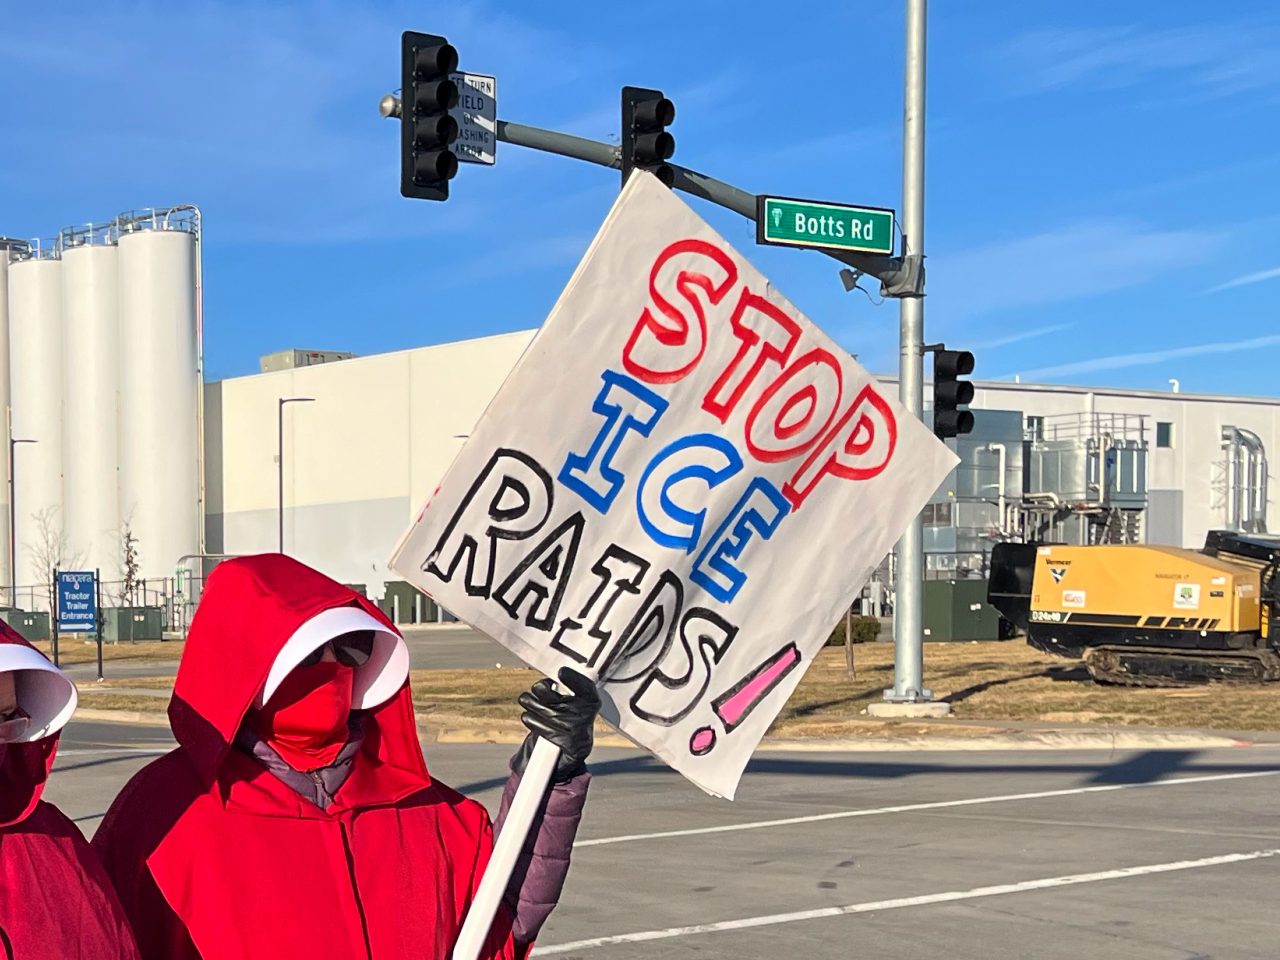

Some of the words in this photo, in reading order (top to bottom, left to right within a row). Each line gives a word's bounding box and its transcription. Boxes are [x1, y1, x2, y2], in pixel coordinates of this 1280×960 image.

[468, 79, 492, 94] TURN
[457, 95, 484, 111] IELD
[795, 213, 844, 238] Botts
[851, 218, 874, 241] Rd
[622, 239, 898, 513] STOP
[557, 369, 792, 603] ICE
[64, 591, 90, 600] Tractor
[422, 447, 802, 756] RAIDS!
[66, 601, 89, 610] Trailer
[61, 612, 94, 620] Entrance
